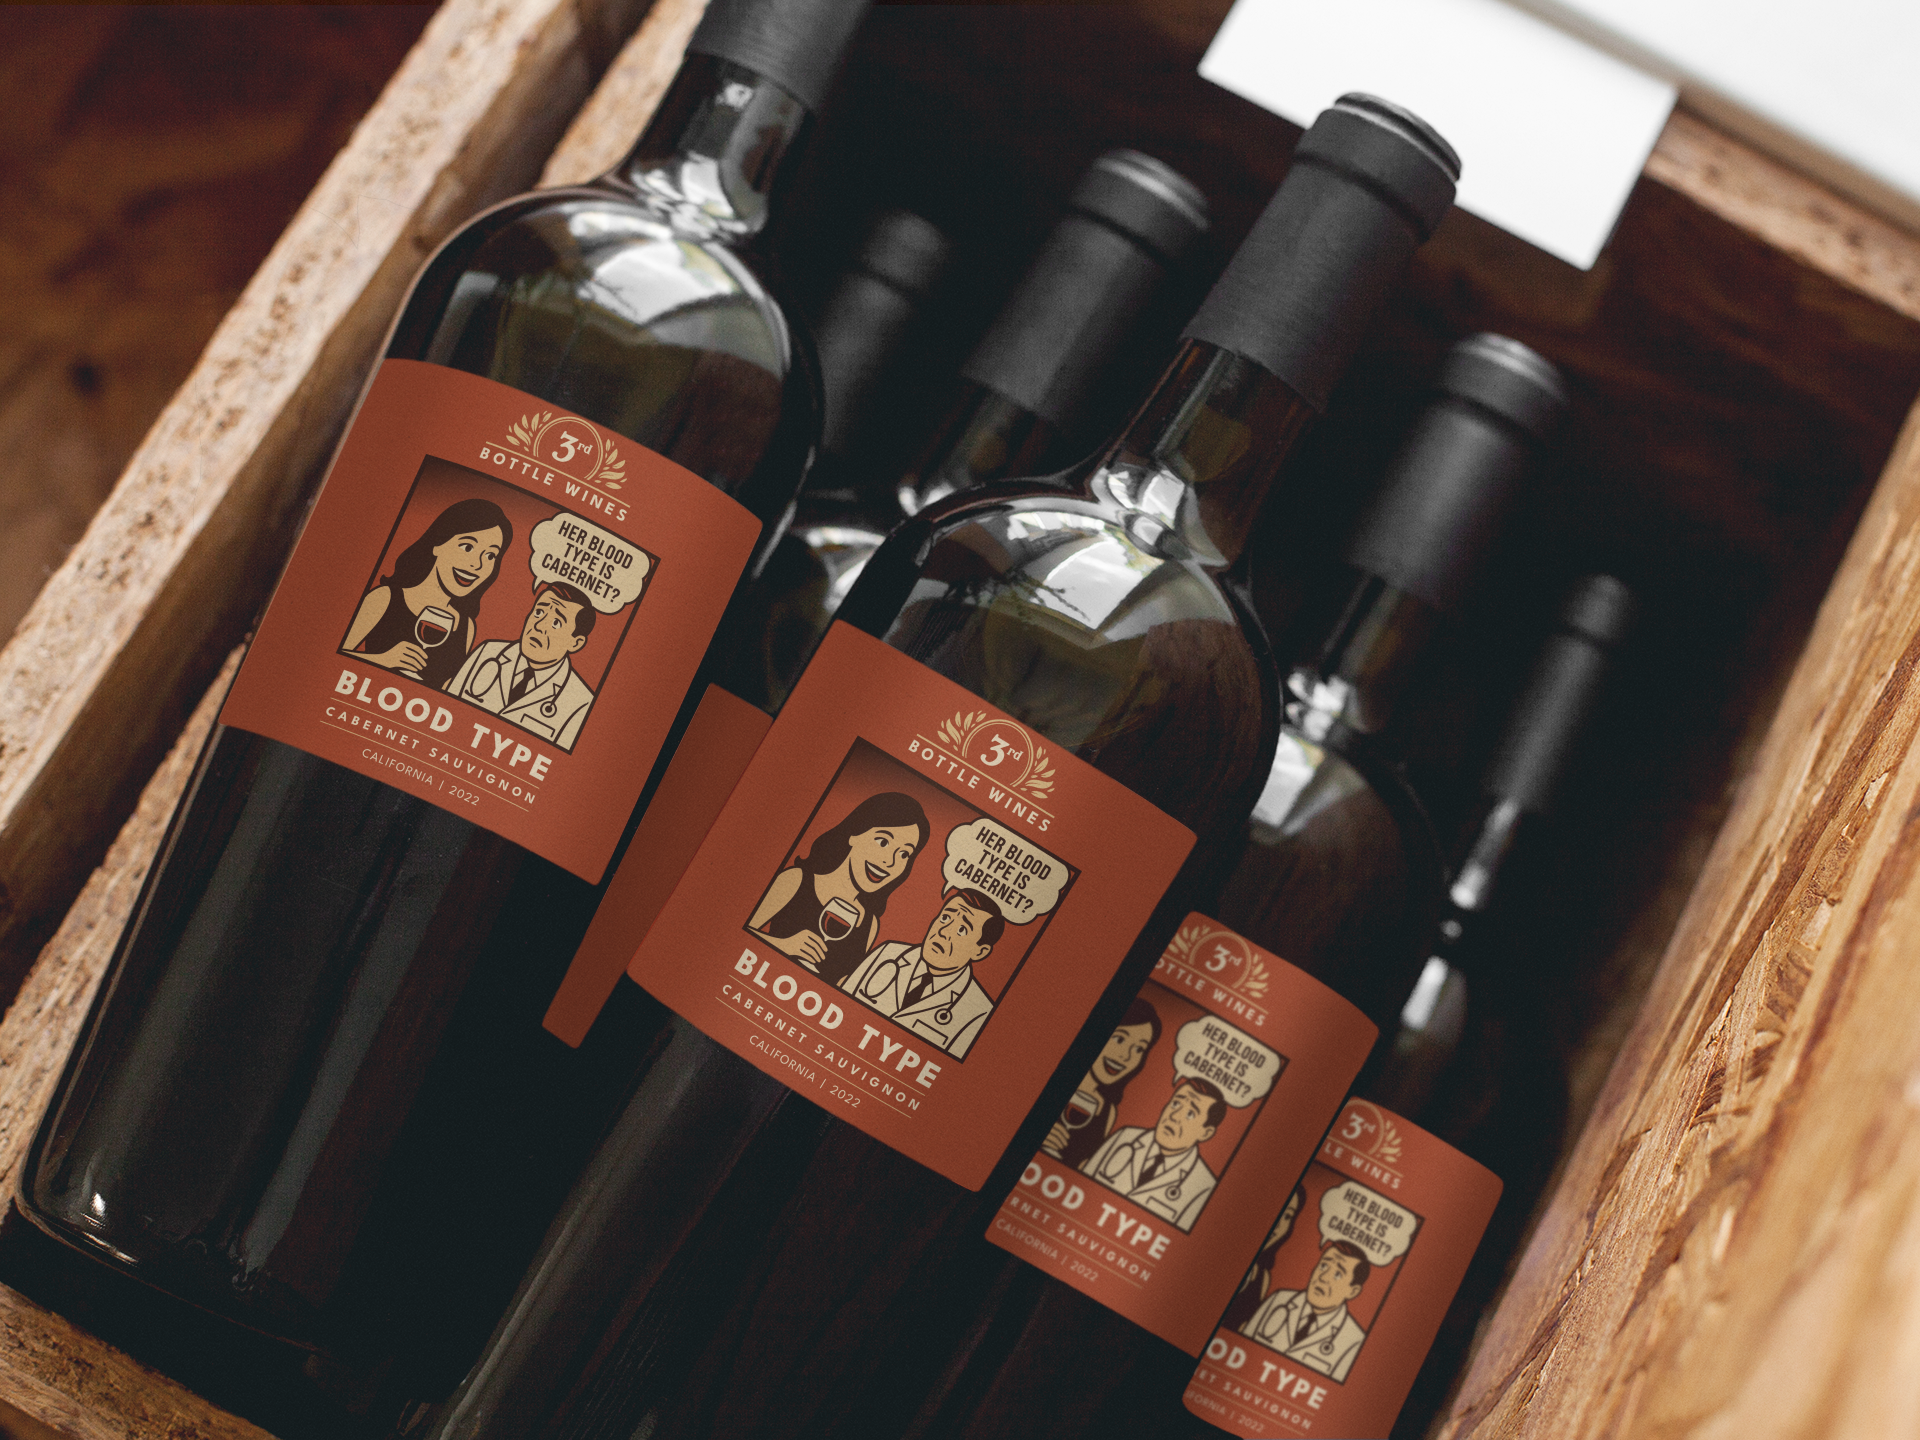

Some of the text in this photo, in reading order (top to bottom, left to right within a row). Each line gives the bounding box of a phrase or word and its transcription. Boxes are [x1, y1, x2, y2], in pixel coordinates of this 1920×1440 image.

[552, 430, 593, 464] 3rd
[479, 446, 629, 523] BOTTLE WINES
[558, 520, 634, 570] HER BLOOD
[563, 541, 616, 580] TYPE IS
[541, 553, 621, 604] CABERNET?
[334, 669, 553, 783] BLOOD TYPE
[980, 733, 1024, 767] 3rd
[325, 705, 536, 805] CABERNET SAUVIGNON
[361, 748, 434, 786] CALIFORNIA
[449, 784, 481, 806] 2022
[908, 740, 1052, 833] BOTTLE WINES
[975, 826, 1052, 881] HER BLOOD
[977, 849, 1031, 890] TYPE IS
[954, 858, 1034, 915] CABERNET?
[1205, 944, 1243, 972] 3rd
[1155, 957, 1266, 1026] OTTLE WINES
[734, 948, 942, 1089] BLOOD TYPE
[722, 984, 921, 1111] CABERNET SAUVIGNON
[1201, 1022, 1267, 1069] HER BLOOD
[1204, 1042, 1249, 1078] TYPE IS
[748, 1035, 815, 1083] CALIFORNIA
[829, 1085, 862, 1109] 2022
[1183, 1050, 1252, 1098] CABERNET?
[1350, 1155, 1401, 1189] WINES
[1019, 1162, 1171, 1260] OOD TYPE
[1343, 1188, 1404, 1229] HER BLOOD
[1347, 1206, 1389, 1238] TYPE IS
[996, 1218, 1058, 1260] CALIFORNIA
[1070, 1260, 1099, 1282] 2022
[1010, 1196, 1152, 1282] RNET SAUVIGNON
[1328, 1215, 1392, 1257] CABERNET?
[1223, 1381, 1313, 1430] SAUVIGNON
[1259, 1361, 1328, 1410] TYPE
